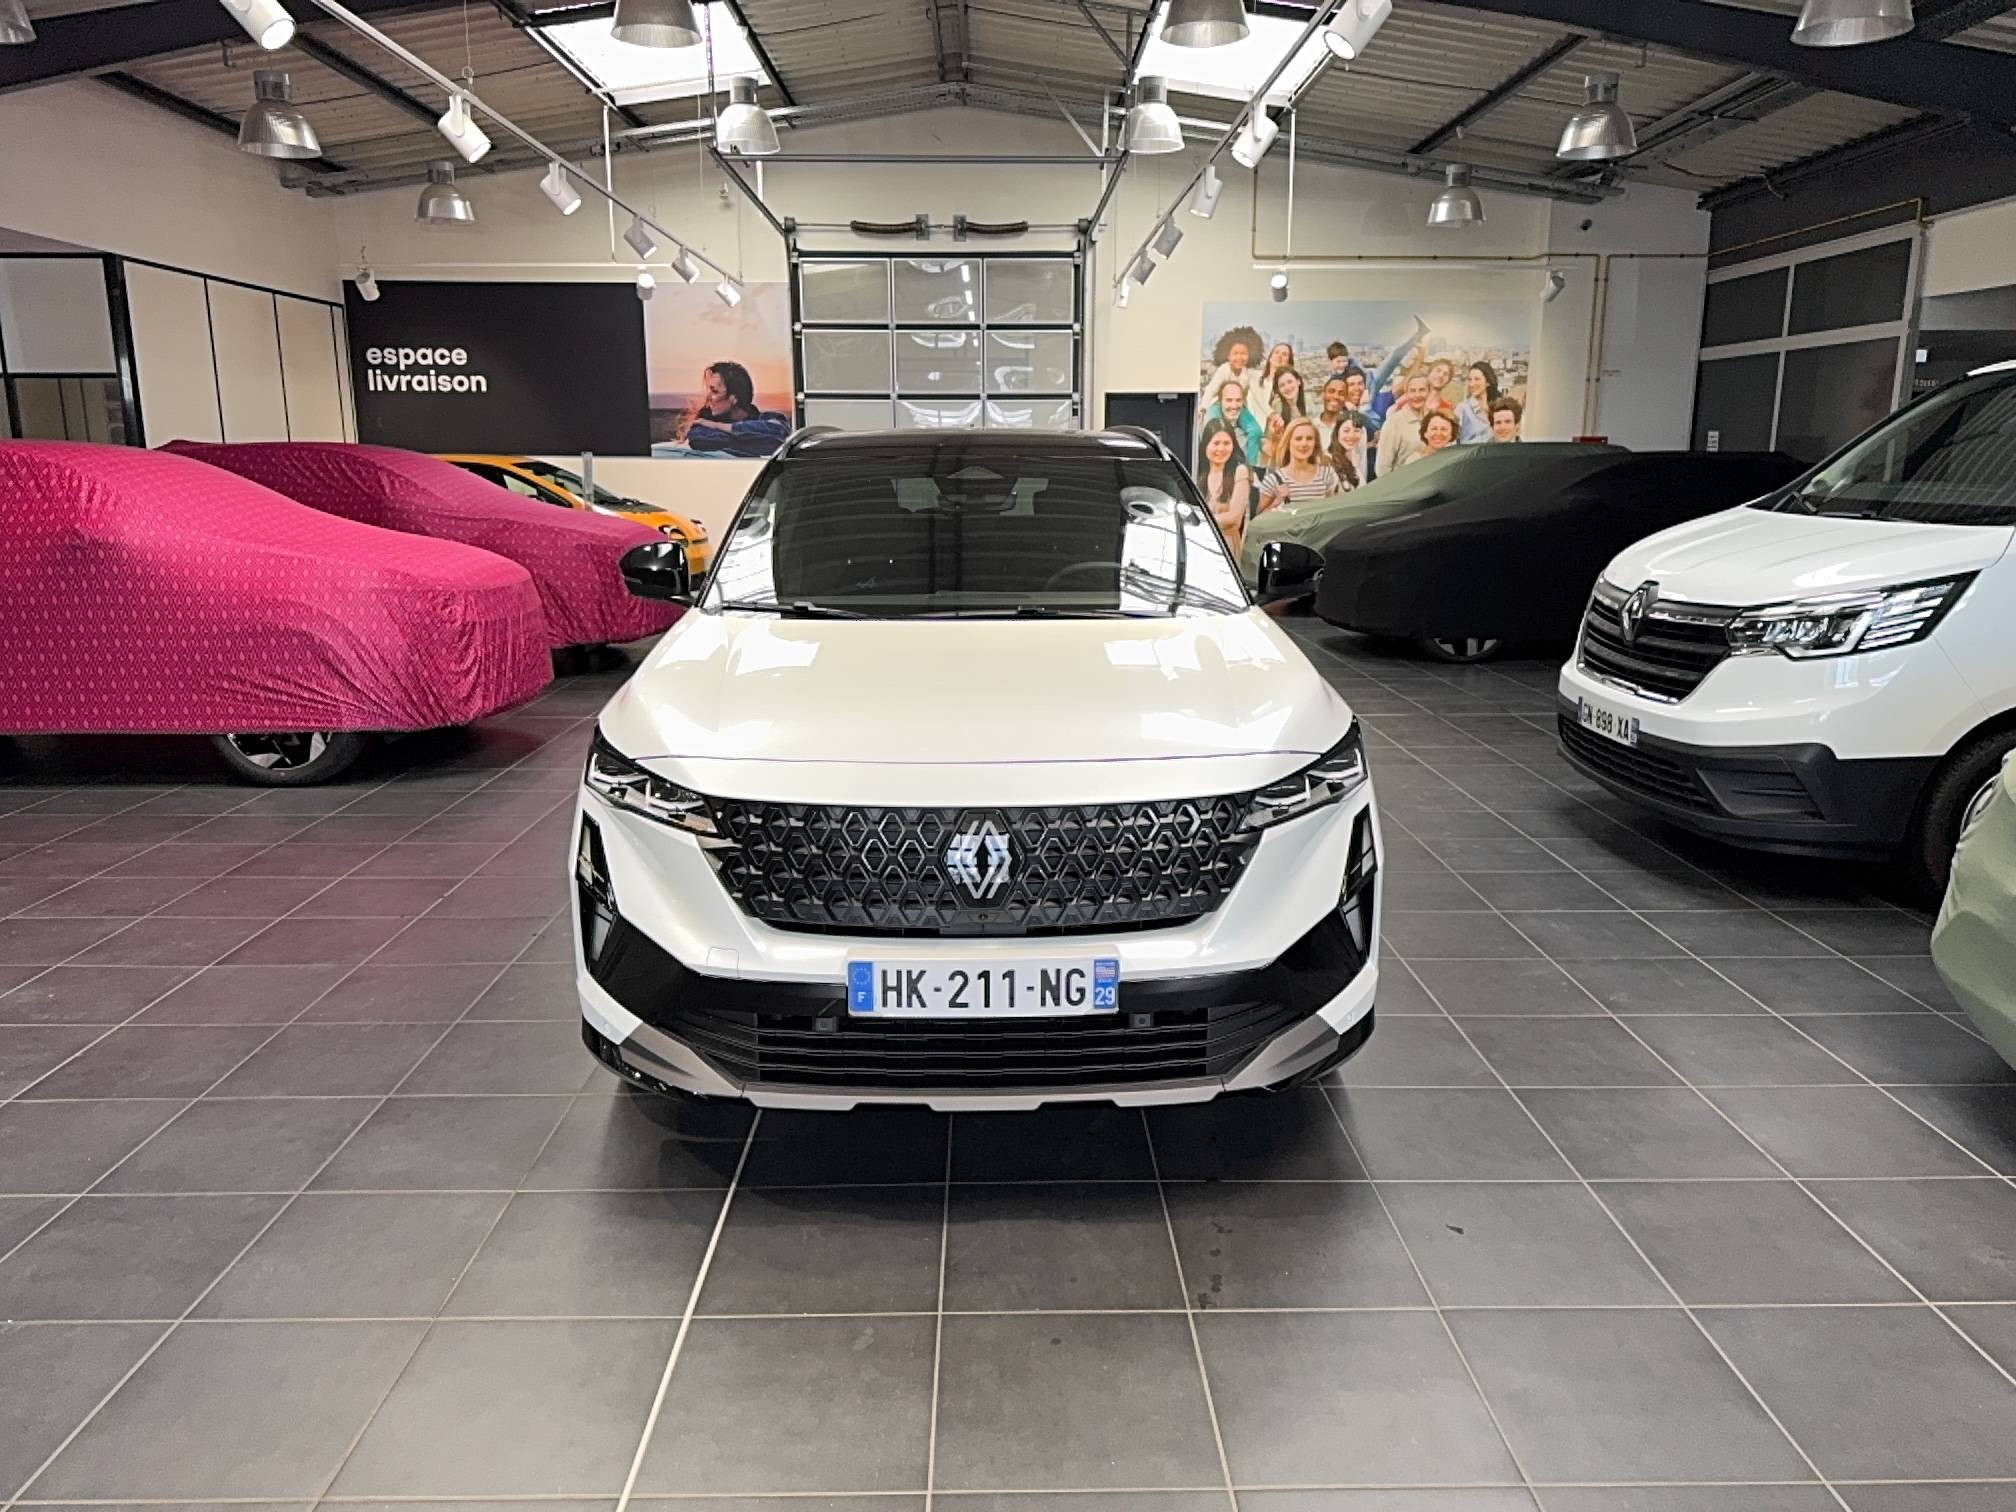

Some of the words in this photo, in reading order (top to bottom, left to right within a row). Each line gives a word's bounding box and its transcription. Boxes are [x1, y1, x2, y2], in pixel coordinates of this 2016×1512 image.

[366, 347, 468, 370] espace
[367, 369, 488, 392] livraison
[857, 991, 867, 1003] F
[881, 968, 1087, 1008] HK-211-NG
[1095, 986, 1115, 1005] 29
